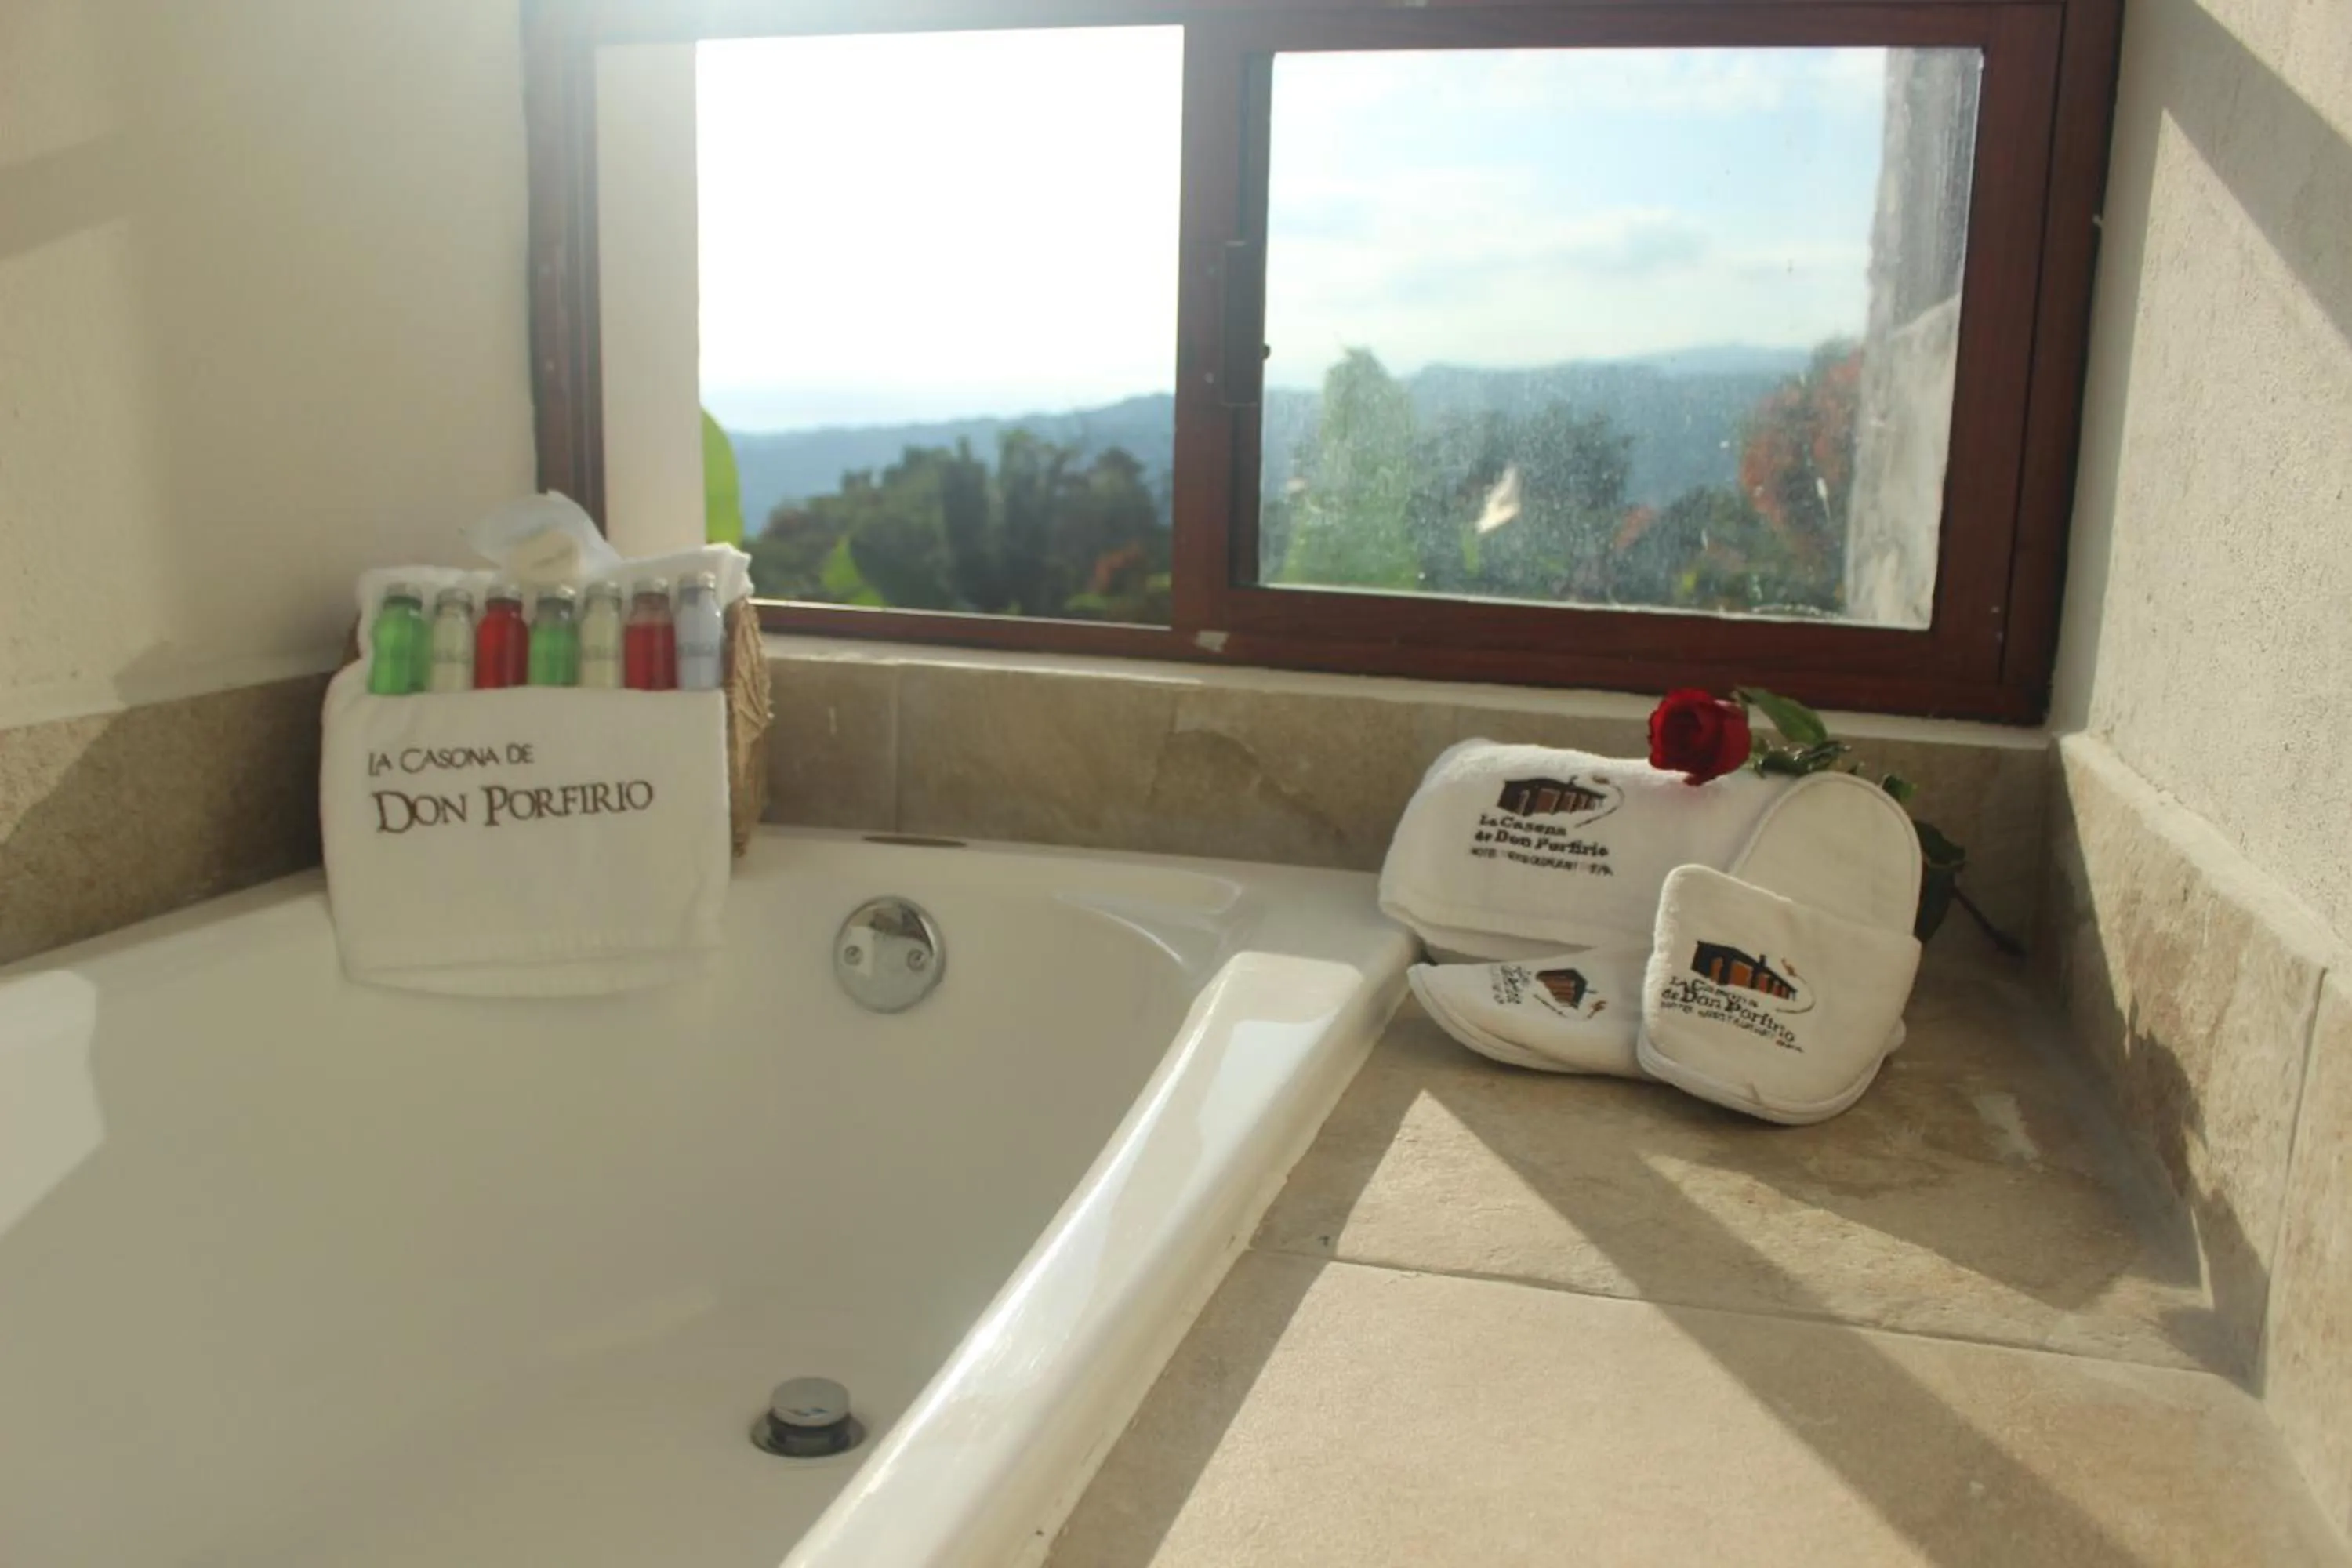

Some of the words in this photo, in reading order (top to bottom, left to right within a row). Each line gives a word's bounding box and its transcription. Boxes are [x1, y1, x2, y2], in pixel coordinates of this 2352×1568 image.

[368, 751, 392, 776] LA
[399, 747, 500, 774] CASONA
[506, 743, 535, 764] DE
[372, 790, 468, 833] DON
[481, 780, 653, 826] PORFIRIO
[1479, 813, 1498, 826] La
[1499, 816, 1567, 837] Casona
[1474, 829, 1493, 843] de
[1494, 829, 1532, 848] Don
[1534, 837, 1609, 857] Porfirio
[1661, 989, 1679, 1000] de
[1680, 985, 1722, 1010] Don
[1725, 994, 1795, 1042] Porfirio
